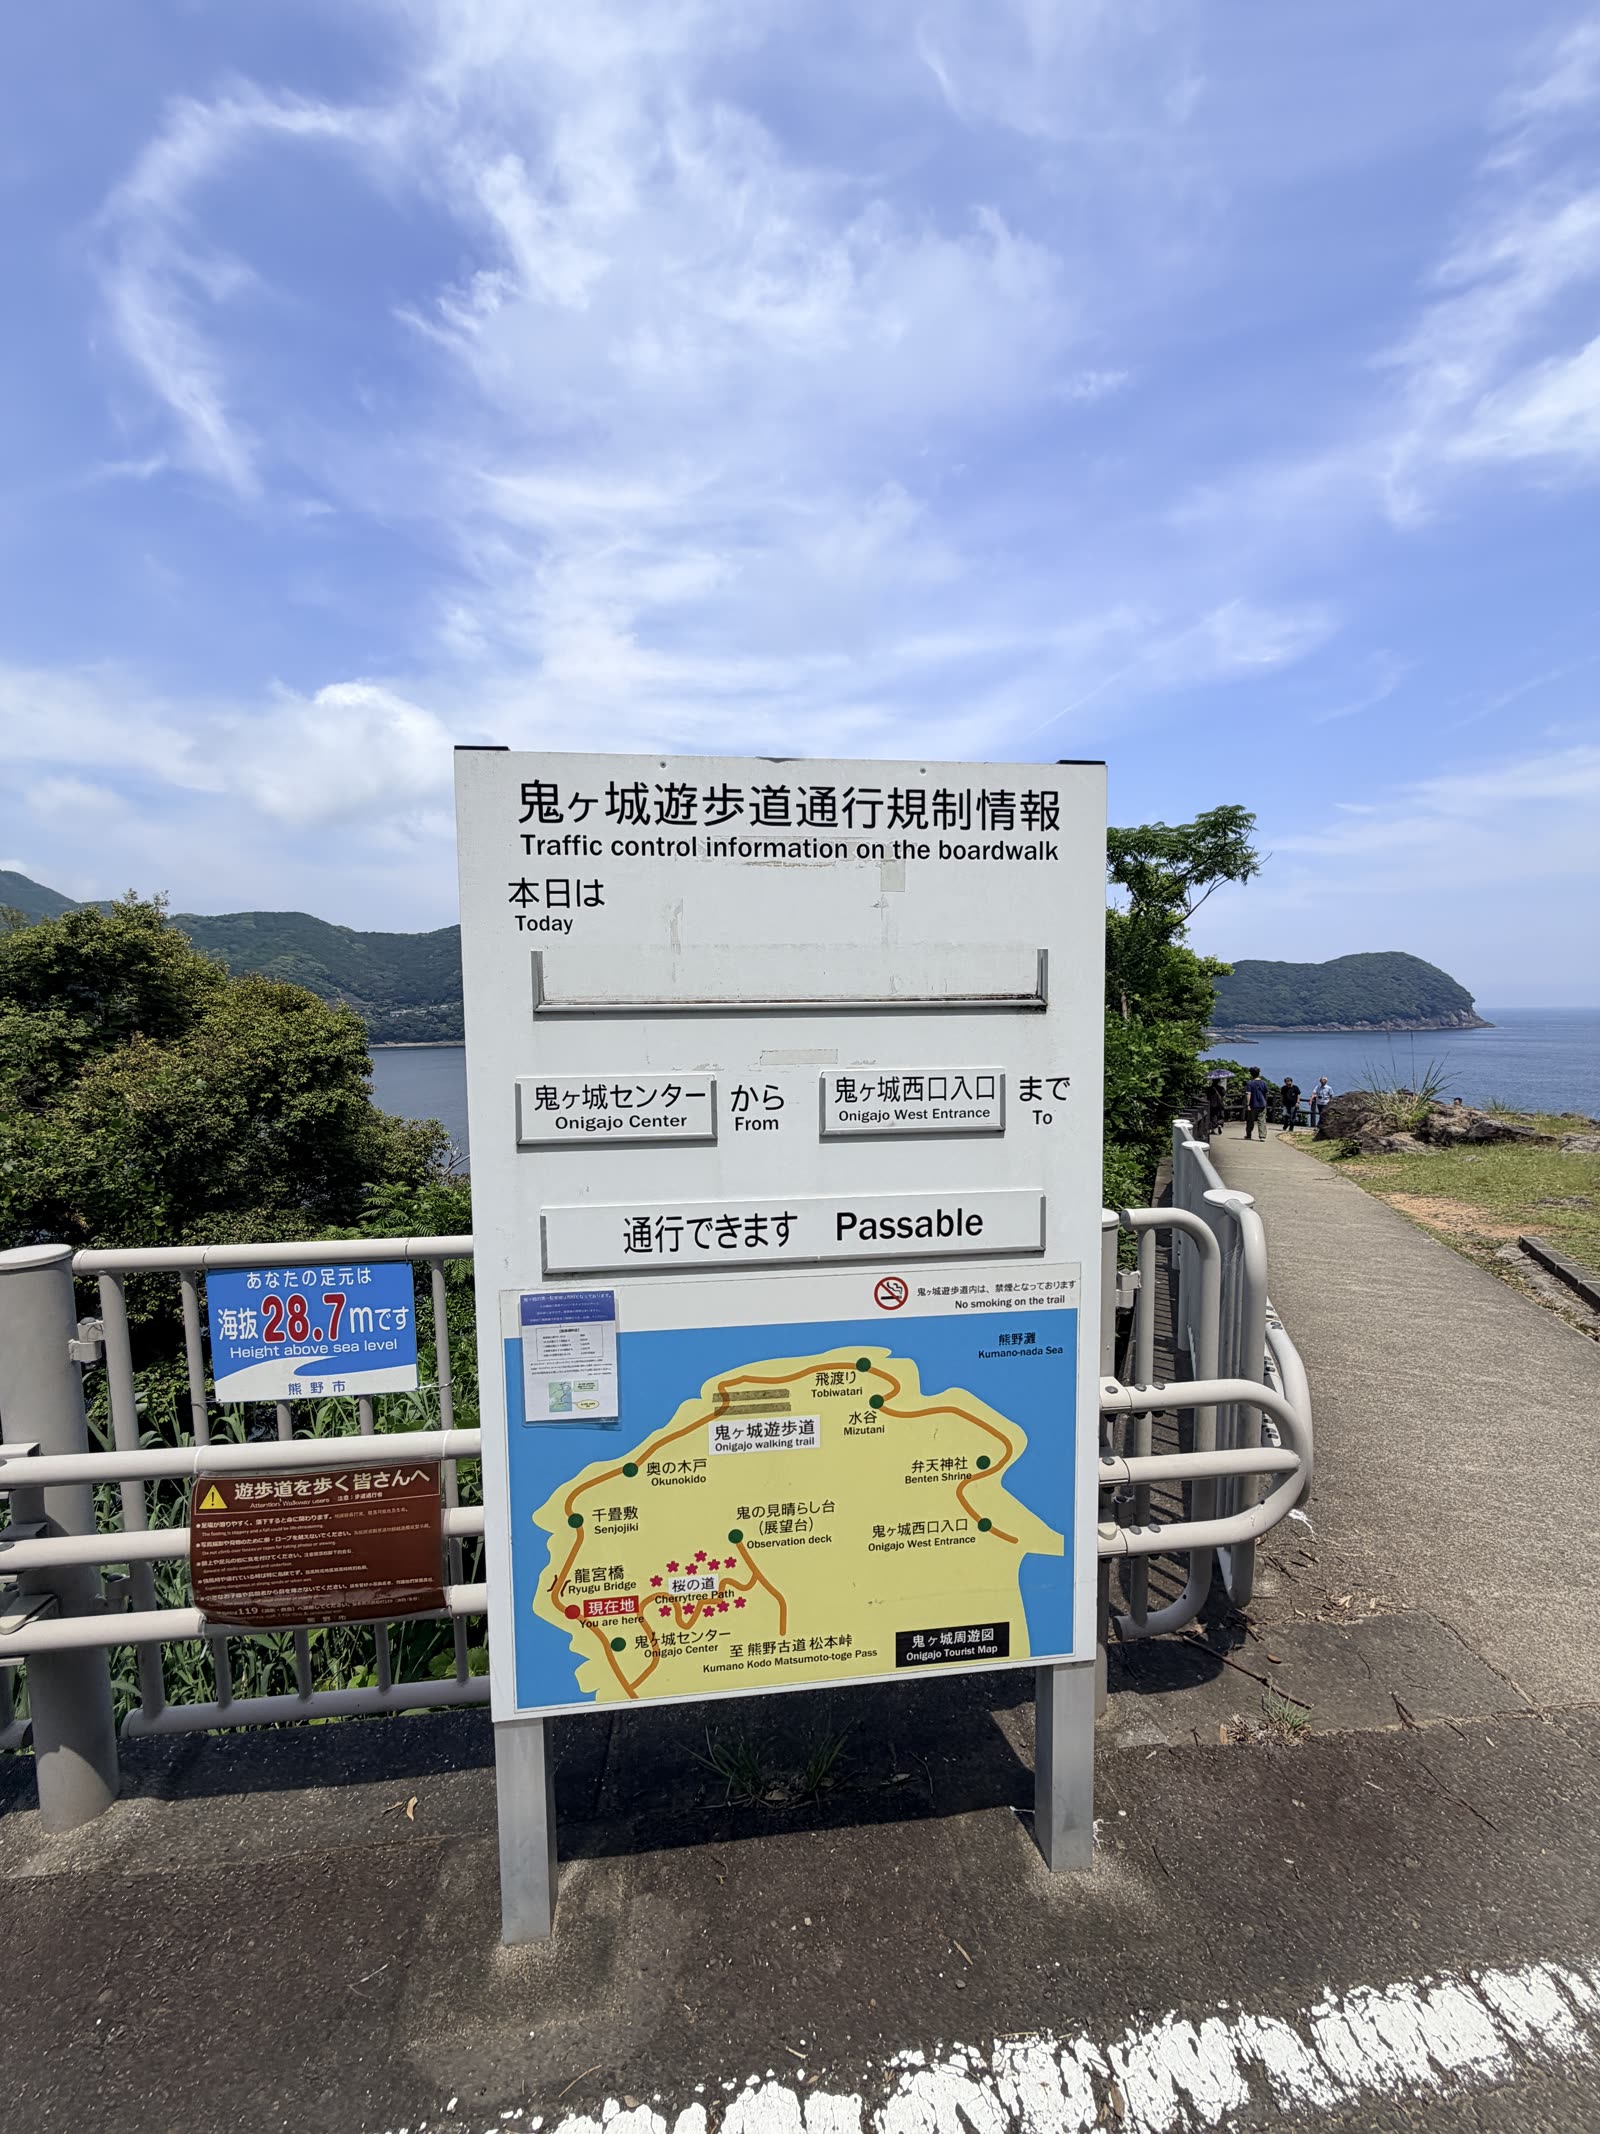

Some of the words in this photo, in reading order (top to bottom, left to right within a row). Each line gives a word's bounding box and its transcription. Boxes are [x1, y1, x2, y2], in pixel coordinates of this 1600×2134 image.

[518, 779, 1061, 832] 鬼ヶ城遊歩道通行規制情報
[521, 834, 602, 857] Traffic
[611, 837, 698, 858] control
[706, 837, 848, 859] information
[856, 843, 884, 860] on
[893, 840, 930, 860] the
[938, 840, 1059, 861] boardwalk
[507, 877, 606, 909] 本日は
[515, 914, 573, 935] Today
[534, 1083, 706, 1111] 鬼ヶ城センター
[834, 1074, 996, 1105] 鬼ヶ城西口入口
[1018, 1075, 1071, 1103] まで
[730, 1083, 785, 1112] から
[555, 1115, 623, 1133] Onigajo
[629, 1114, 687, 1129] Center
[839, 1109, 890, 1124] Onigajo
[894, 1108, 928, 1120] West
[933, 1107, 990, 1119] Entrance
[1032, 1110, 1053, 1125] To
[735, 1116, 778, 1132] From
[836, 1206, 984, 1241] Passable
[623, 1210, 798, 1254] 通行できます
[247, 1267, 372, 1289] あなたの足元は
[955, 1300, 968, 1309] No
[971, 1298, 1012, 1308] smoking
[1029, 1296, 1044, 1305] the
[1047, 1295, 1065, 1304] trail
[998, 1332, 1036, 1346] 熊野灘
[230, 1346, 279, 1359] Height
[284, 1344, 328, 1356] above
[334, 1342, 359, 1352] sea
[365, 1339, 397, 1351] level
[979, 1347, 1043, 1359] Kumano-nada
[1046, 1346, 1063, 1354] Sea
[816, 1371, 856, 1386] 飛渡り
[811, 1387, 862, 1398] Tobiwatari
[849, 1411, 877, 1424] 水谷
[715, 1419, 815, 1441] 鬼ヶ城遊歩道
[844, 1425, 884, 1435] Mizutani
[715, 1441, 752, 1452] Onigajo
[755, 1439, 793, 1450] walking
[796, 1437, 814, 1446] trail
[646, 1459, 707, 1476] 奥の木戸
[912, 1457, 968, 1473] 弁天神社
[235, 1469, 430, 1500] 遊歩道を歩く皆さんへ
[651, 1474, 706, 1486] Okunokido
[905, 1475, 938, 1484] Benten
[942, 1472, 972, 1481] Shrine
[592, 1506, 638, 1522] 千畳敷
[736, 1500, 835, 1520] 鬼の見晴らし台
[594, 1523, 638, 1535] Senjojiki
[872, 1519, 968, 1538] 鬼ヶ城西口入口
[747, 1536, 806, 1549] Observation
[808, 1535, 832, 1544] deck
[868, 1541, 905, 1552] Onigajo
[907, 1539, 932, 1547] West
[934, 1536, 976, 1546] Entrance
[574, 1565, 624, 1583] 龍宮橋
[569, 1582, 601, 1595] Ryugu
[604, 1580, 636, 1592] Bridge
[672, 1577, 715, 1592] 桜の道
[655, 1591, 709, 1604] Cherrytree
[712, 1590, 734, 1599] Path
[588, 1599, 634, 1615] 現在地
[579, 1619, 601, 1629] You
[603, 1618, 619, 1626] are
[622, 1615, 644, 1625] here
[635, 1629, 731, 1649] 鬼ヶ城センター
[912, 1628, 994, 1649] 鬼ヶ城周遊図
[644, 1646, 683, 1658] Onigajo
[685, 1643, 718, 1654] Center
[907, 1650, 941, 1661] Onigajo
[944, 1647, 975, 1657] Tourist
[978, 1645, 998, 1655] Map
[703, 1661, 744, 1673] Kumano
[747, 1659, 771, 1670] Kodo
[774, 1651, 852, 1666] Matsumoto-toge
[855, 1649, 877, 1658] Pass
